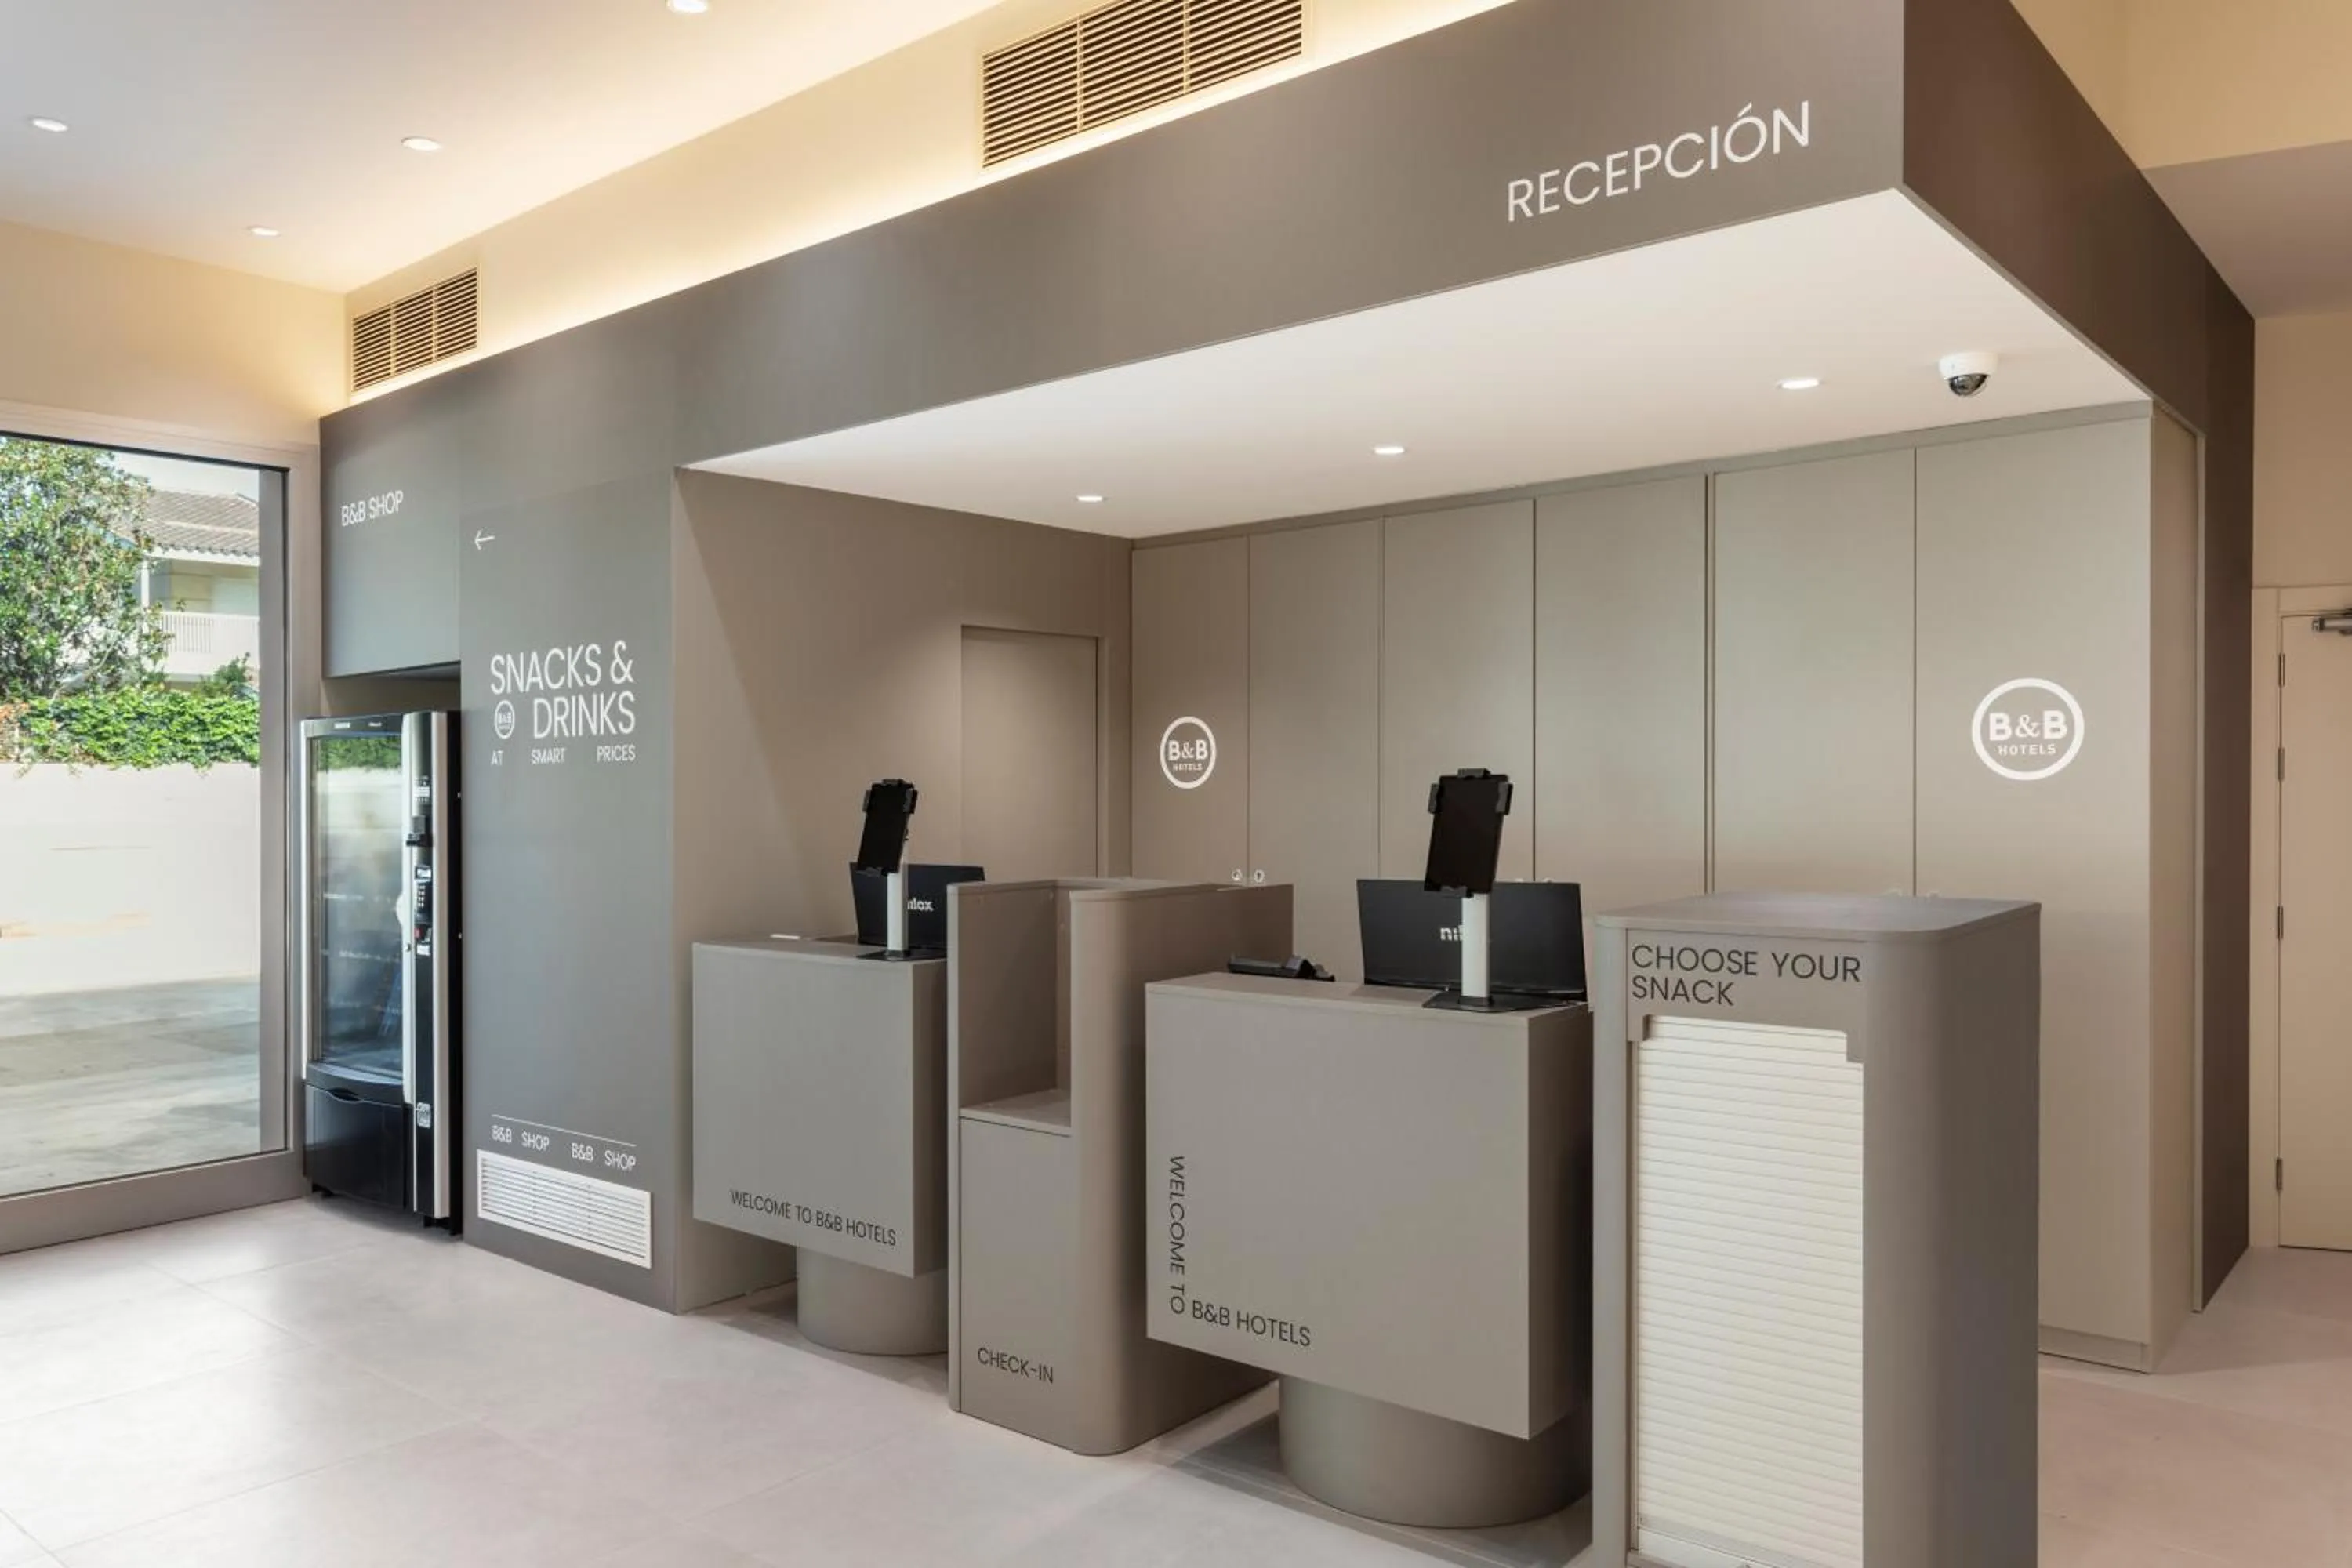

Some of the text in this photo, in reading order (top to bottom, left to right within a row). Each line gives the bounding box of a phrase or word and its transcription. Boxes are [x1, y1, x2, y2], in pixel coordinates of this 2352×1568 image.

[1508, 100, 1809, 222] RECEPCIÓN
[341, 490, 404, 527] B&B SHOP
[490, 640, 634, 695] SNACKS &
[533, 690, 636, 739] DRINKS
[1989, 710, 2067, 741] B&B
[491, 744, 636, 765] AT SMART PRICES
[1168, 739, 1208, 760] B&B
[1998, 743, 2056, 756] HOTELS
[1632, 944, 1862, 982] CHOOSE YOUR
[1632, 975, 1735, 1007] SNACK
[492, 1125, 637, 1171] B&B SHOP B&B SHOP
[730, 1189, 896, 1246] WELCOME TO B&B HOTELS
[1169, 1156, 1185, 1314] WELCOME TO
[1192, 1299, 1311, 1347] B&B HOTELS
[978, 1347, 1054, 1384] CHECK-IN
